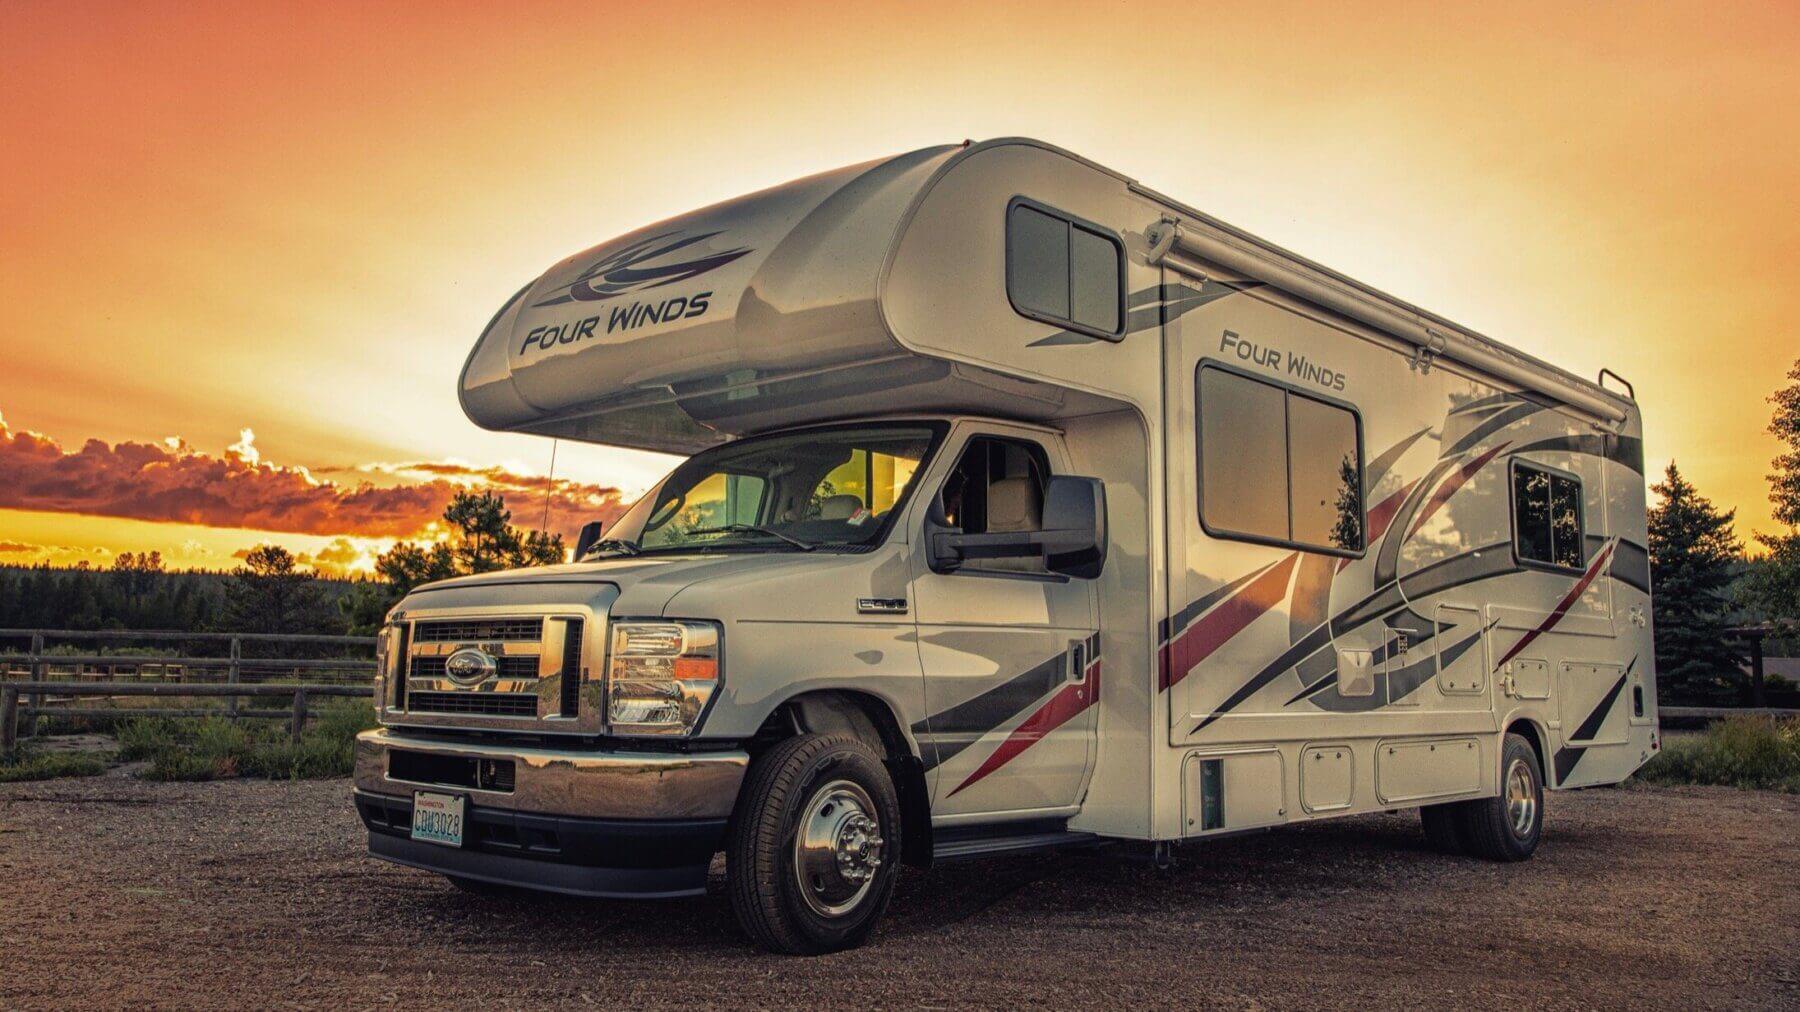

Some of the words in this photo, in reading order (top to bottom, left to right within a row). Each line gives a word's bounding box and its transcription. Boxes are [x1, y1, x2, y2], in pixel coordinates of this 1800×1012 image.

[519, 315, 600, 356] FOUR
[607, 291, 713, 335] WINDS
[1219, 329, 1281, 371] FOUR
[1288, 351, 1346, 392] WINDS
